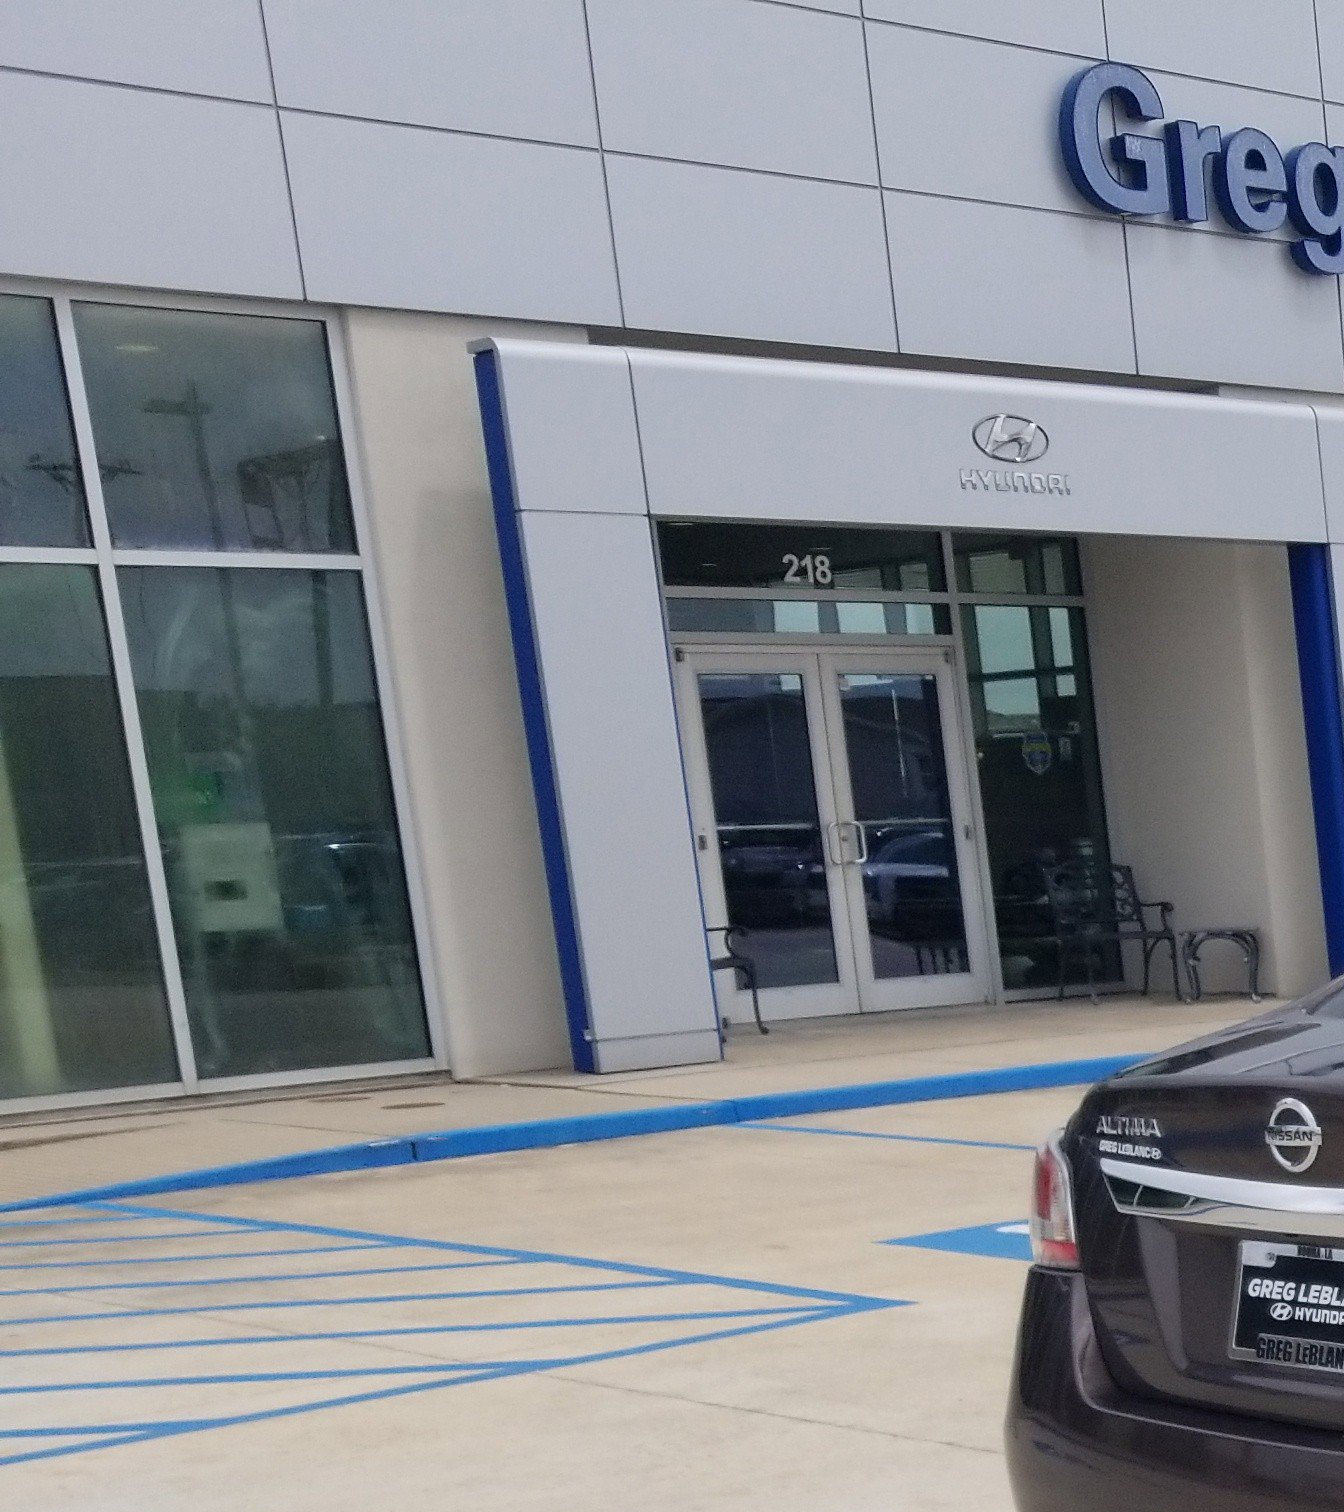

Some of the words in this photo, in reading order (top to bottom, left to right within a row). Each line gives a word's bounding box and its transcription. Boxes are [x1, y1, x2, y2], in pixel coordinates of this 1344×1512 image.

[959, 468, 1071, 496] HYUNDAI
[781, 553, 832, 584] 218
[1096, 1115, 1162, 1138] ALTIMA
[1267, 1127, 1314, 1142] NISSAN
[1247, 1278, 1297, 1302] GREG
[1255, 1336, 1293, 1362] GREG
